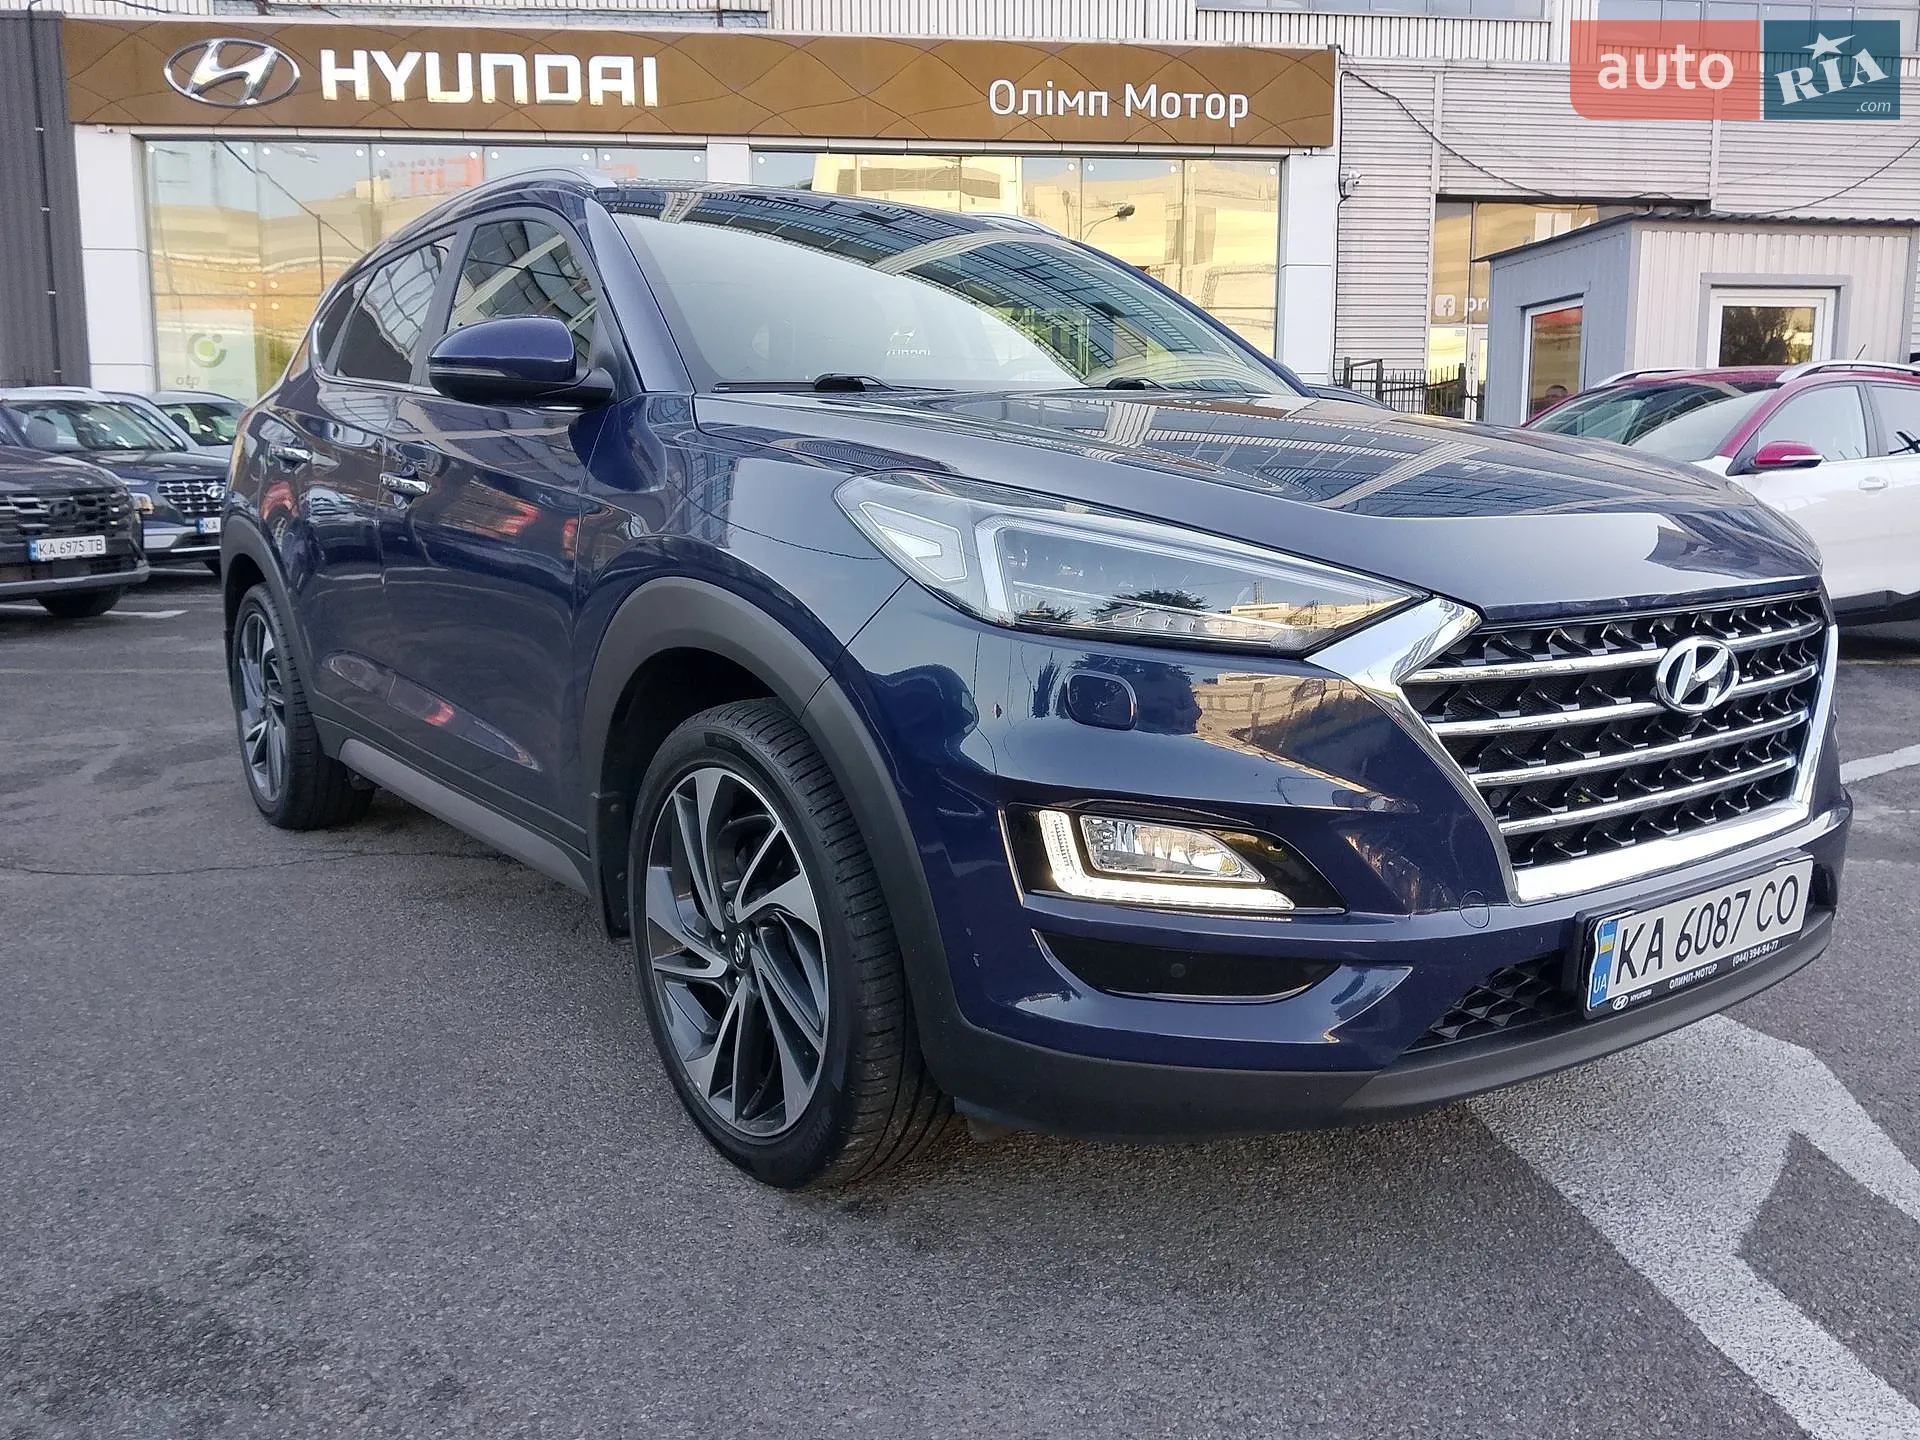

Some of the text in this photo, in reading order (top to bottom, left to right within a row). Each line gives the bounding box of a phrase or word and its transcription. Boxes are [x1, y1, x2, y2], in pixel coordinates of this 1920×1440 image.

[320, 49, 658, 107] HYUNDAI
[988, 79, 1249, 127] Олімп Мотор
[39, 539, 103, 556] KA 6975 TB
[1615, 874, 1799, 985] KA 6087 CO
[1593, 973, 1607, 993] UA
[1630, 988, 1652, 1002] HYUNDAI
